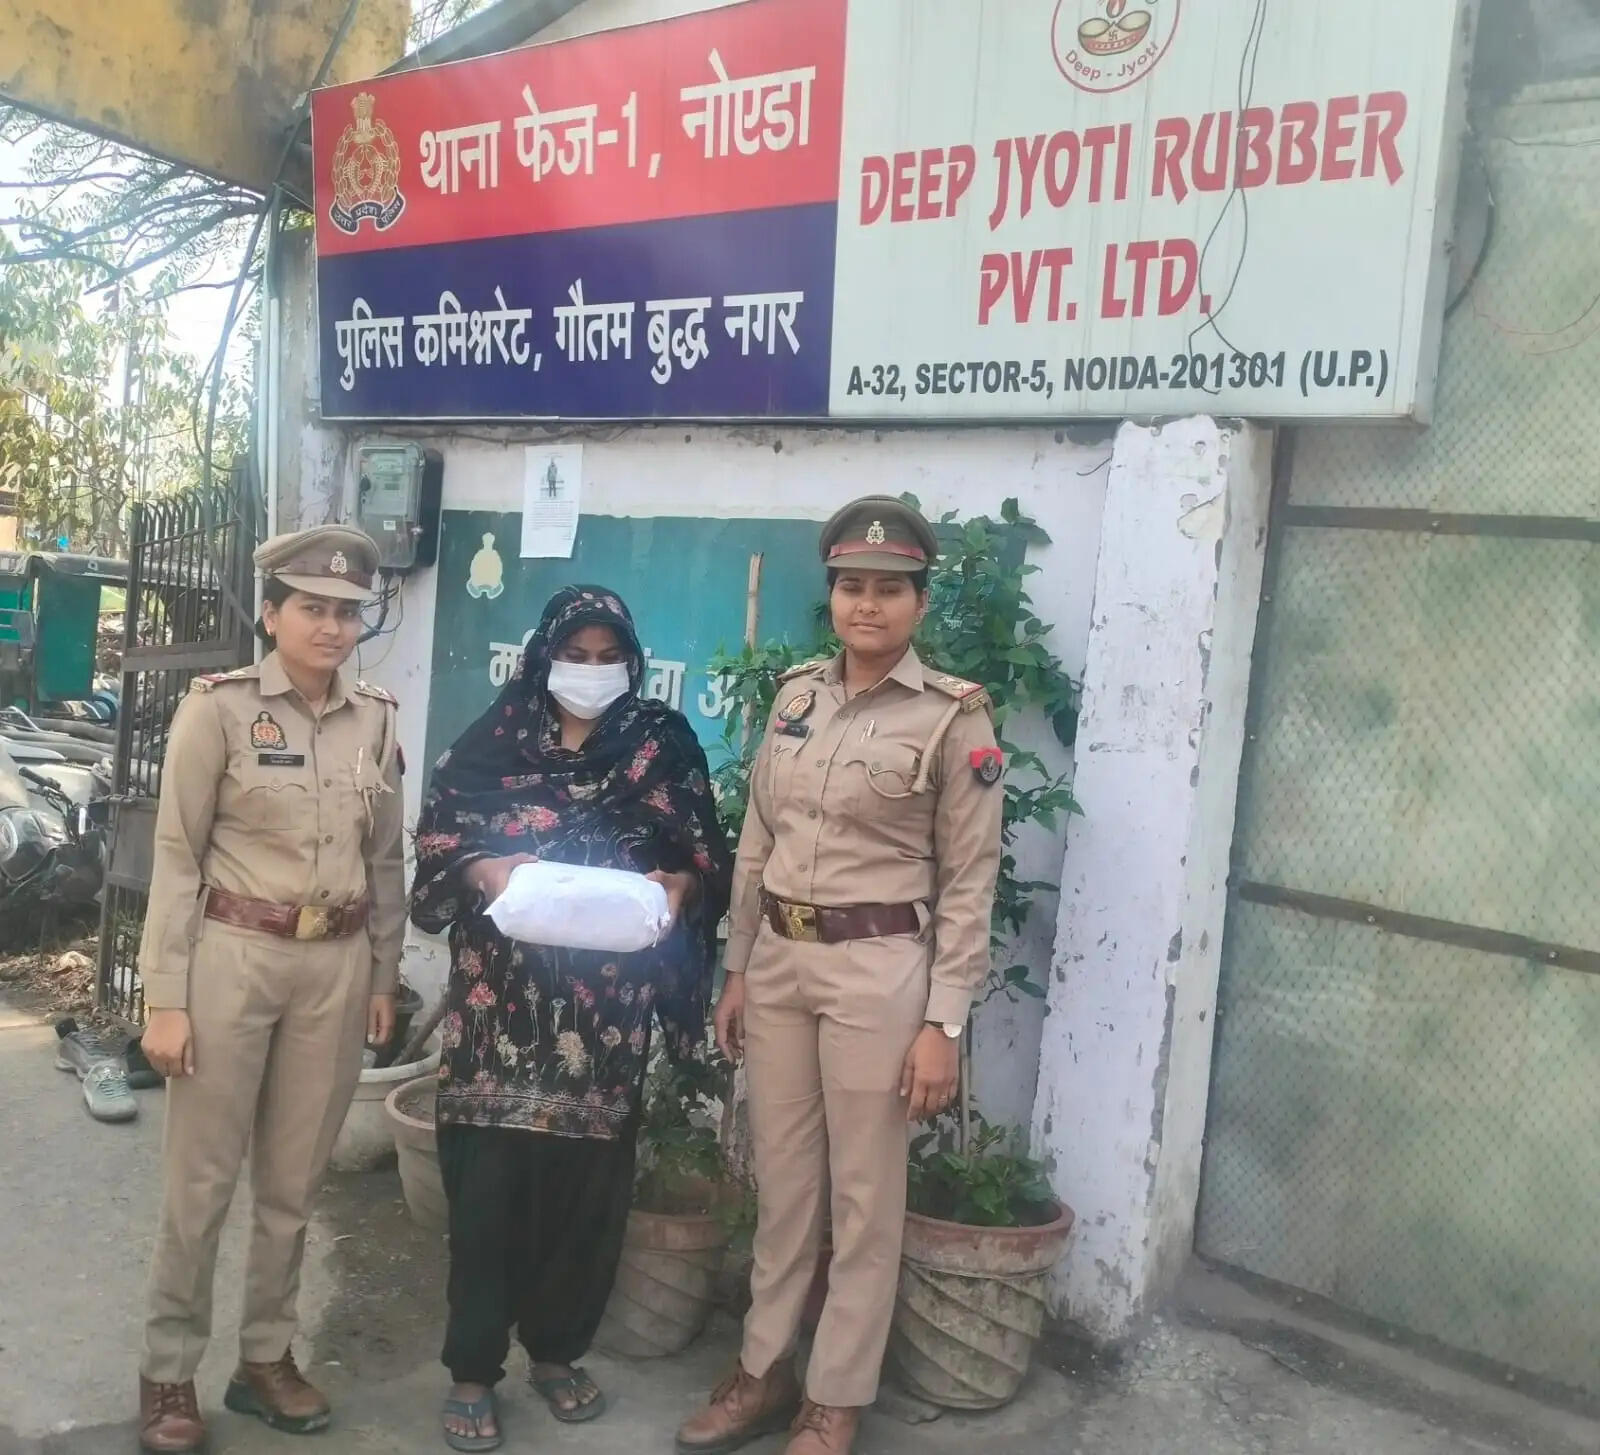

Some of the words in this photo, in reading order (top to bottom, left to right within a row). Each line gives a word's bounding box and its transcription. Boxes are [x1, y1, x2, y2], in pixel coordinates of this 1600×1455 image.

[1065, 49, 1101, 81] Deep
[1117, 41, 1159, 77] Jyoti
[420, 120, 501, 195] थाना
[680, 48, 817, 159] नोएडा
[859, 144, 977, 226] DEEP
[988, 122, 1133, 232] JYOTI
[1151, 90, 1408, 205] RUBBER
[977, 246, 1078, 326] PVT.
[1100, 237, 1212, 319] LTD.
[334, 296, 405, 392] पुलिस
[553, 277, 636, 362] गौतम
[645, 296, 713, 385] बुद्ध
[723, 290, 804, 355] नगर
[846, 365, 907, 401] A-32,
[914, 359, 1054, 399] SECTOR-5,
[1063, 350, 1287, 391] NOIDA-201301
[1300, 348, 1390, 397] (U.P.)
